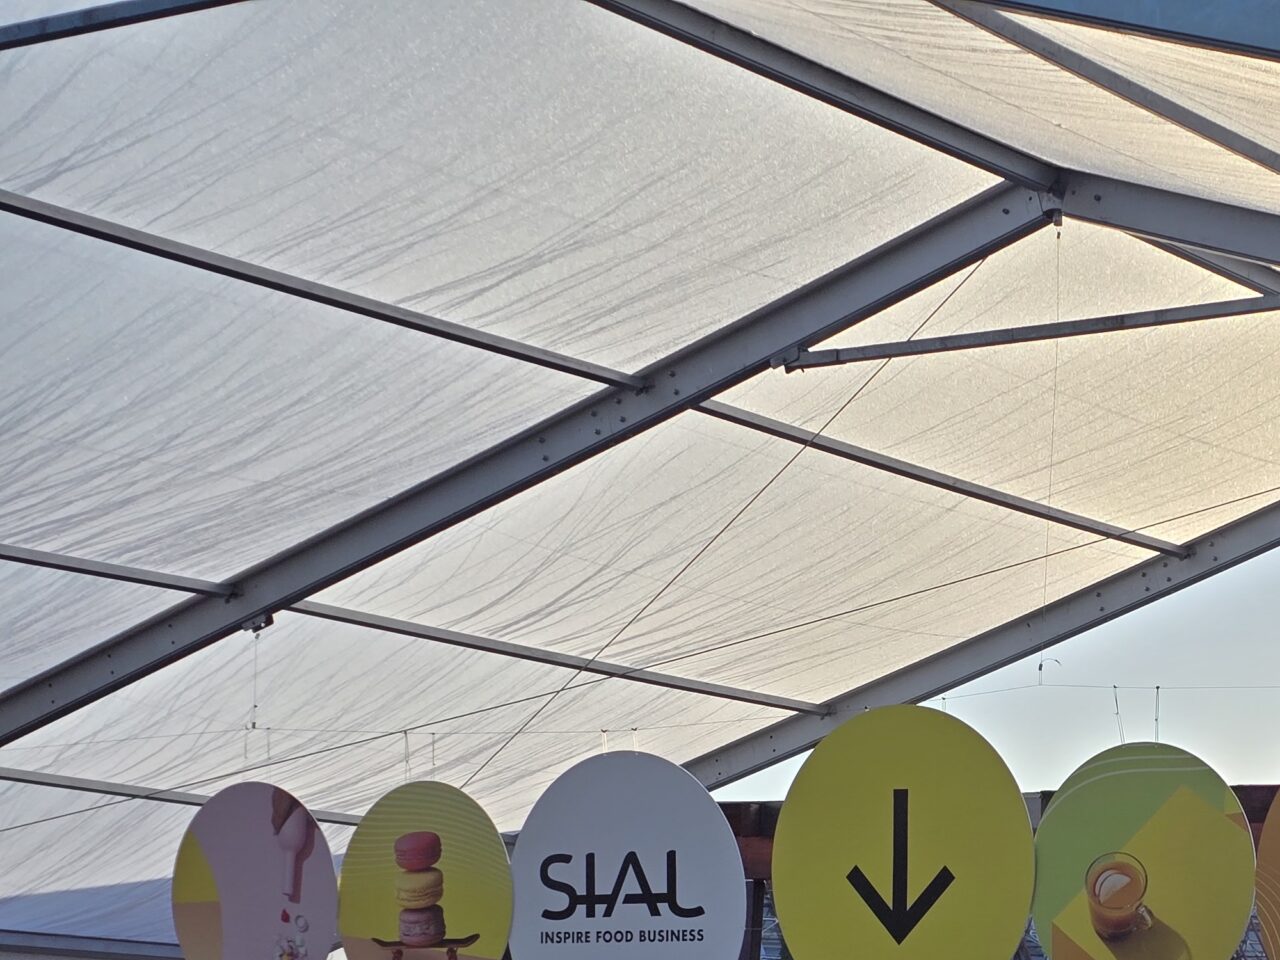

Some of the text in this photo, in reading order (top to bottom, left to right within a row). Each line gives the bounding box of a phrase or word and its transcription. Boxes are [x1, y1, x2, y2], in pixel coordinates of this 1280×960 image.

[540, 850, 705, 920] SIAL
[540, 929, 704, 944] INSPIRE FOOD BUSINESS
